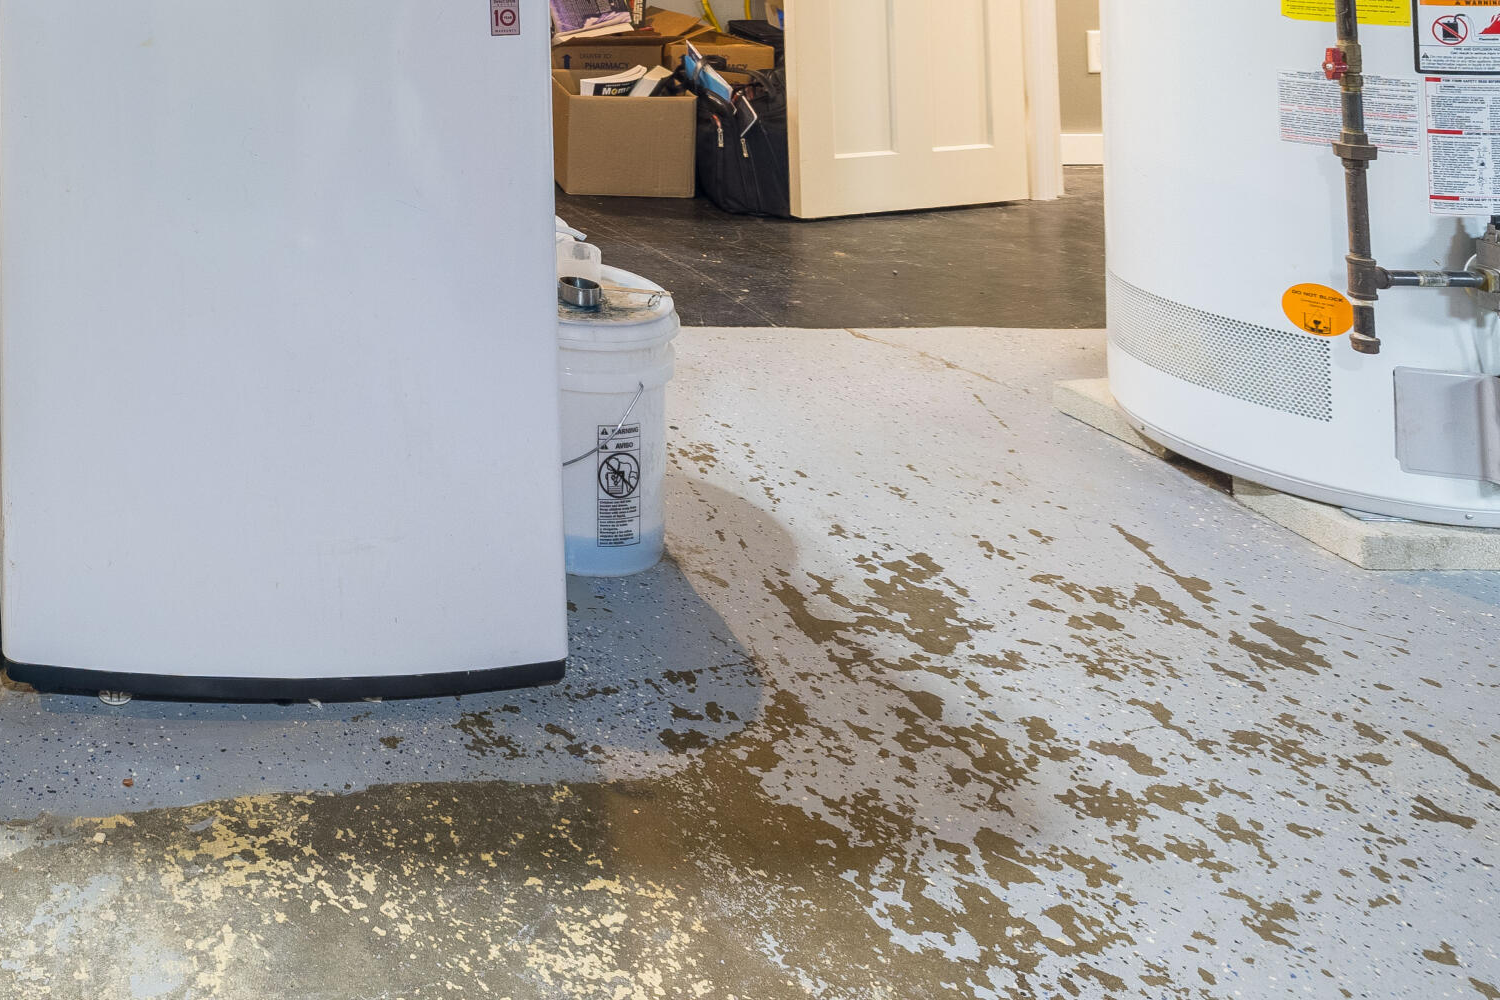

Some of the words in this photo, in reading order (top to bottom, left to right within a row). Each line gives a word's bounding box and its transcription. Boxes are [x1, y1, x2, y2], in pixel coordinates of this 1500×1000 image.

[494, 9, 516, 26] 10
[584, 62, 629, 70] PHARMACY
[1319, 294, 1344, 303] BLOCK
[615, 441, 634, 450] AVISO
